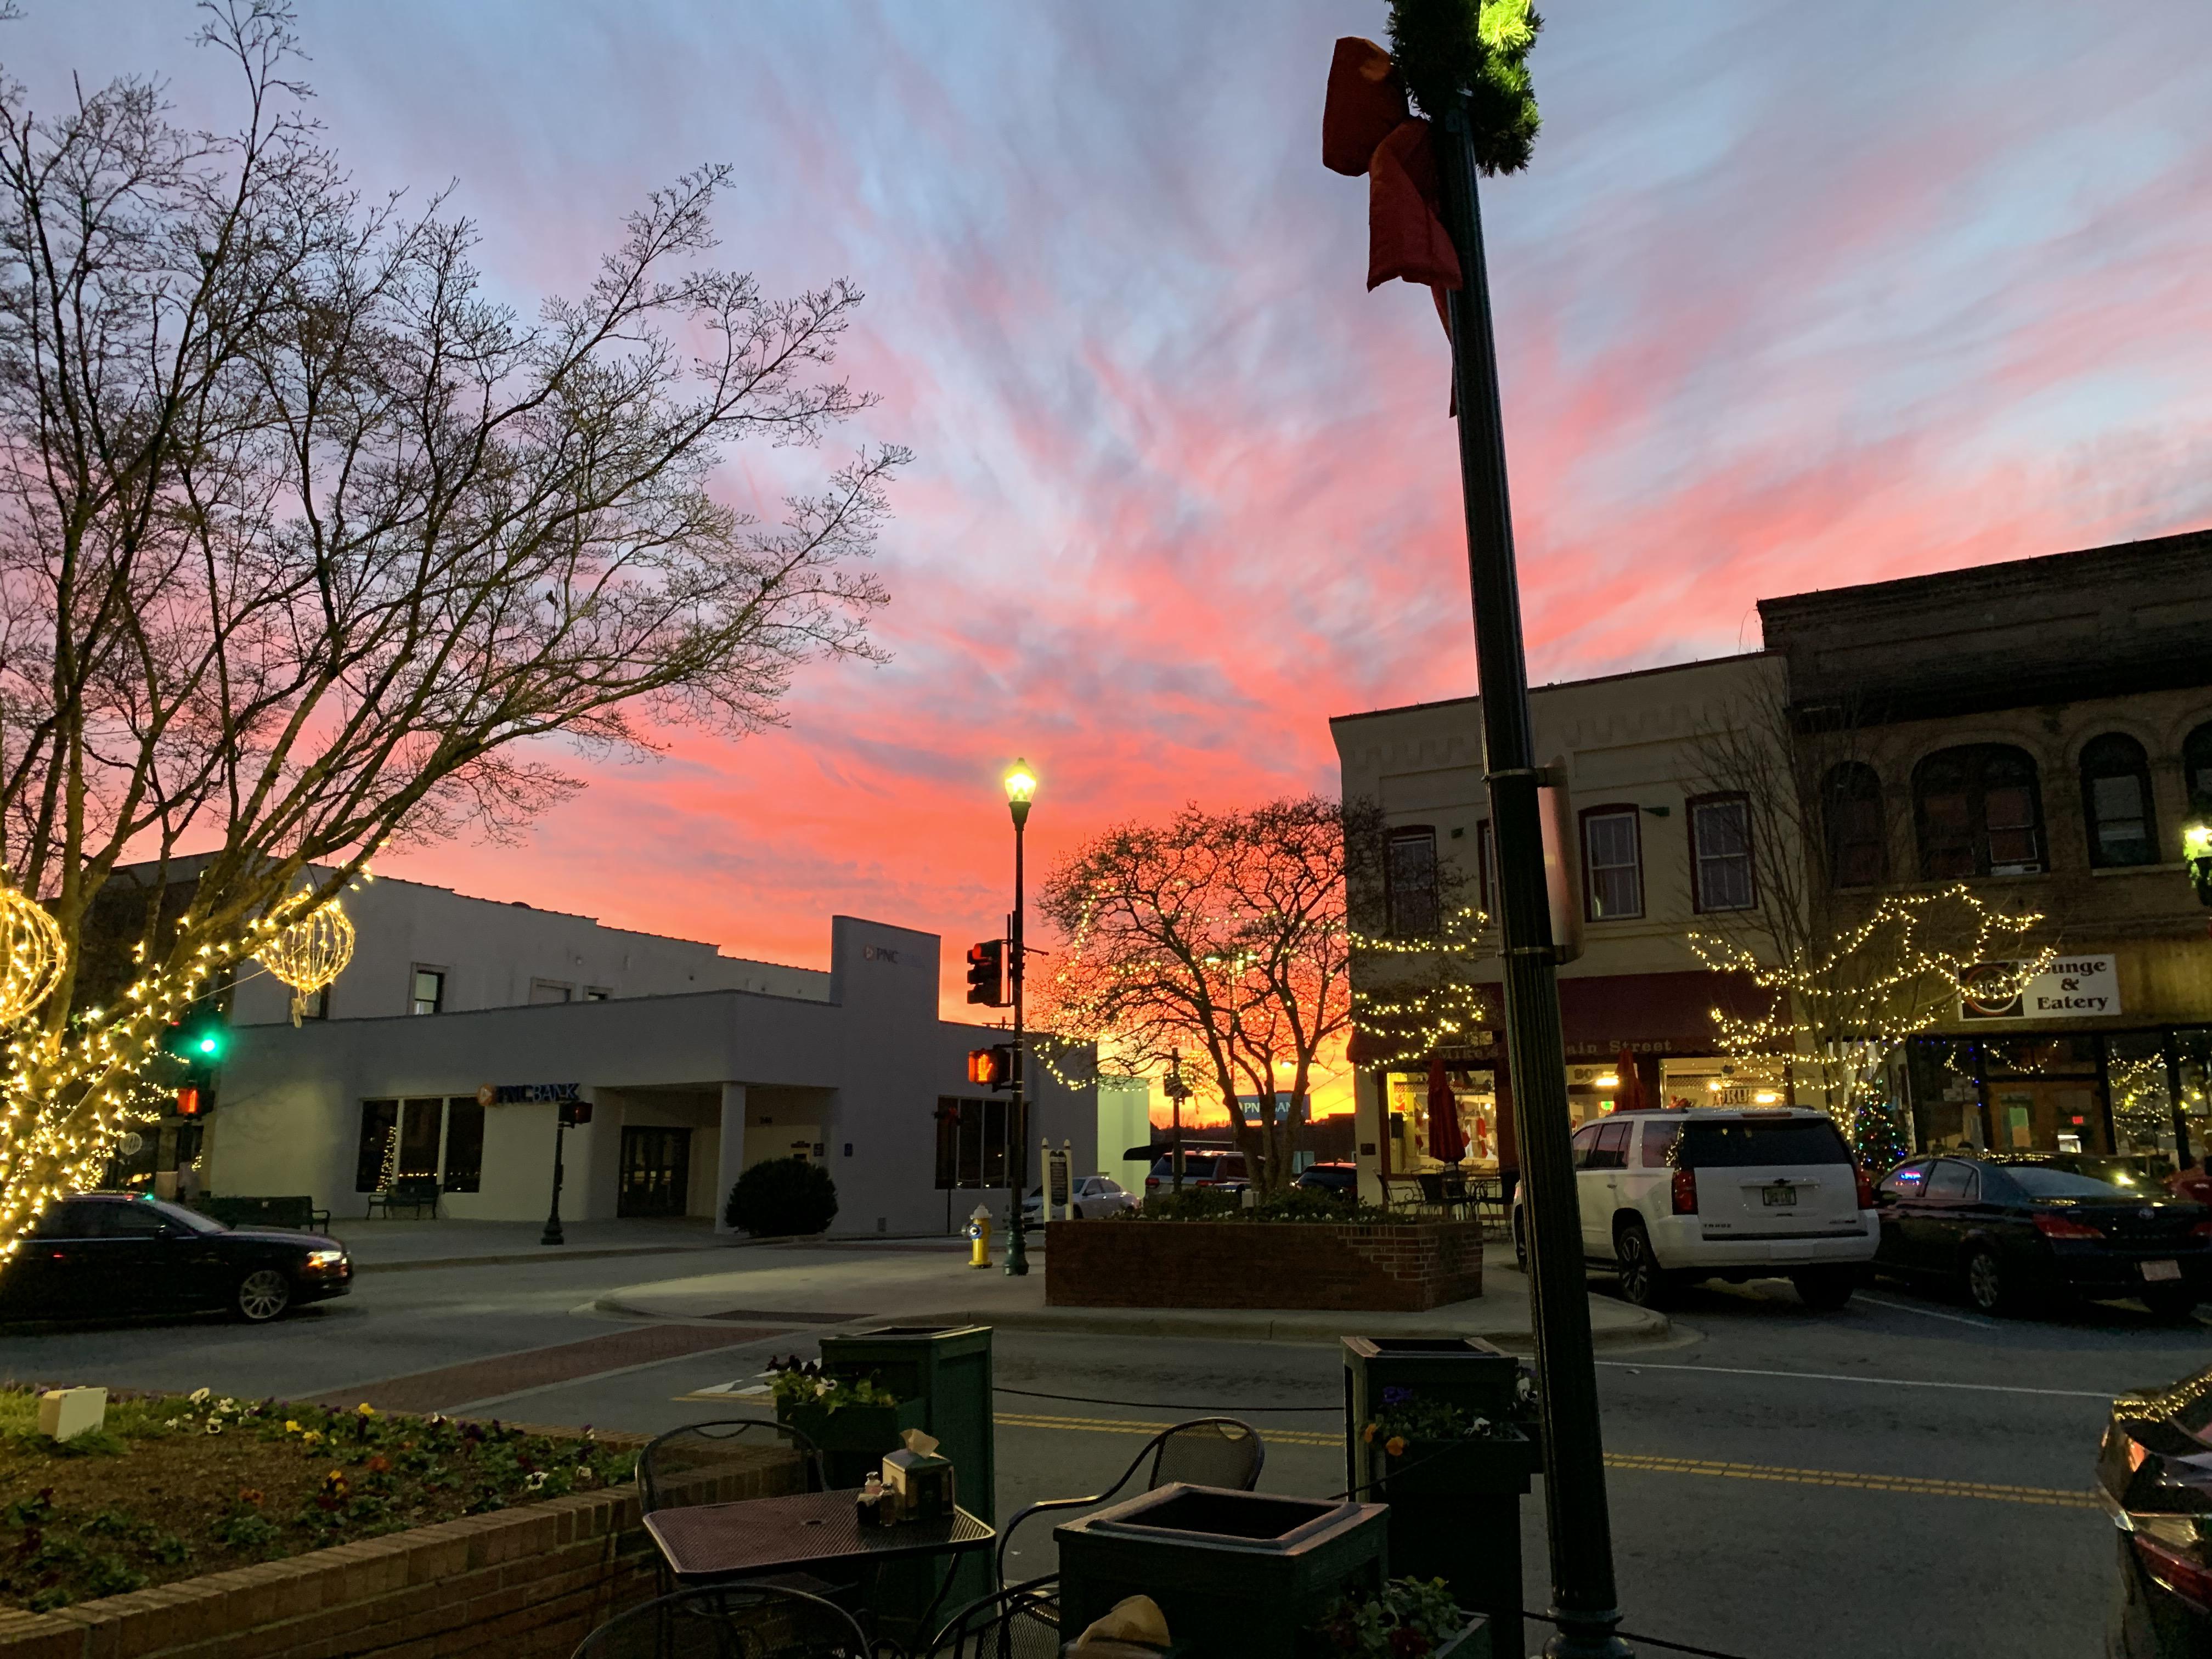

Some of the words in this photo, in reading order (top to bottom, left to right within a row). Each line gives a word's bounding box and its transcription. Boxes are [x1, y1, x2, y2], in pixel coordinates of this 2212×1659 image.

[876, 947, 900, 964] PNC
[2032, 961, 2107, 977] ounge
[2061, 978, 2079, 991] &
[2036, 996, 2109, 1011] Eatery
[1566, 1042, 1598, 1054] ain
[1609, 1039, 1672, 1053] Street
